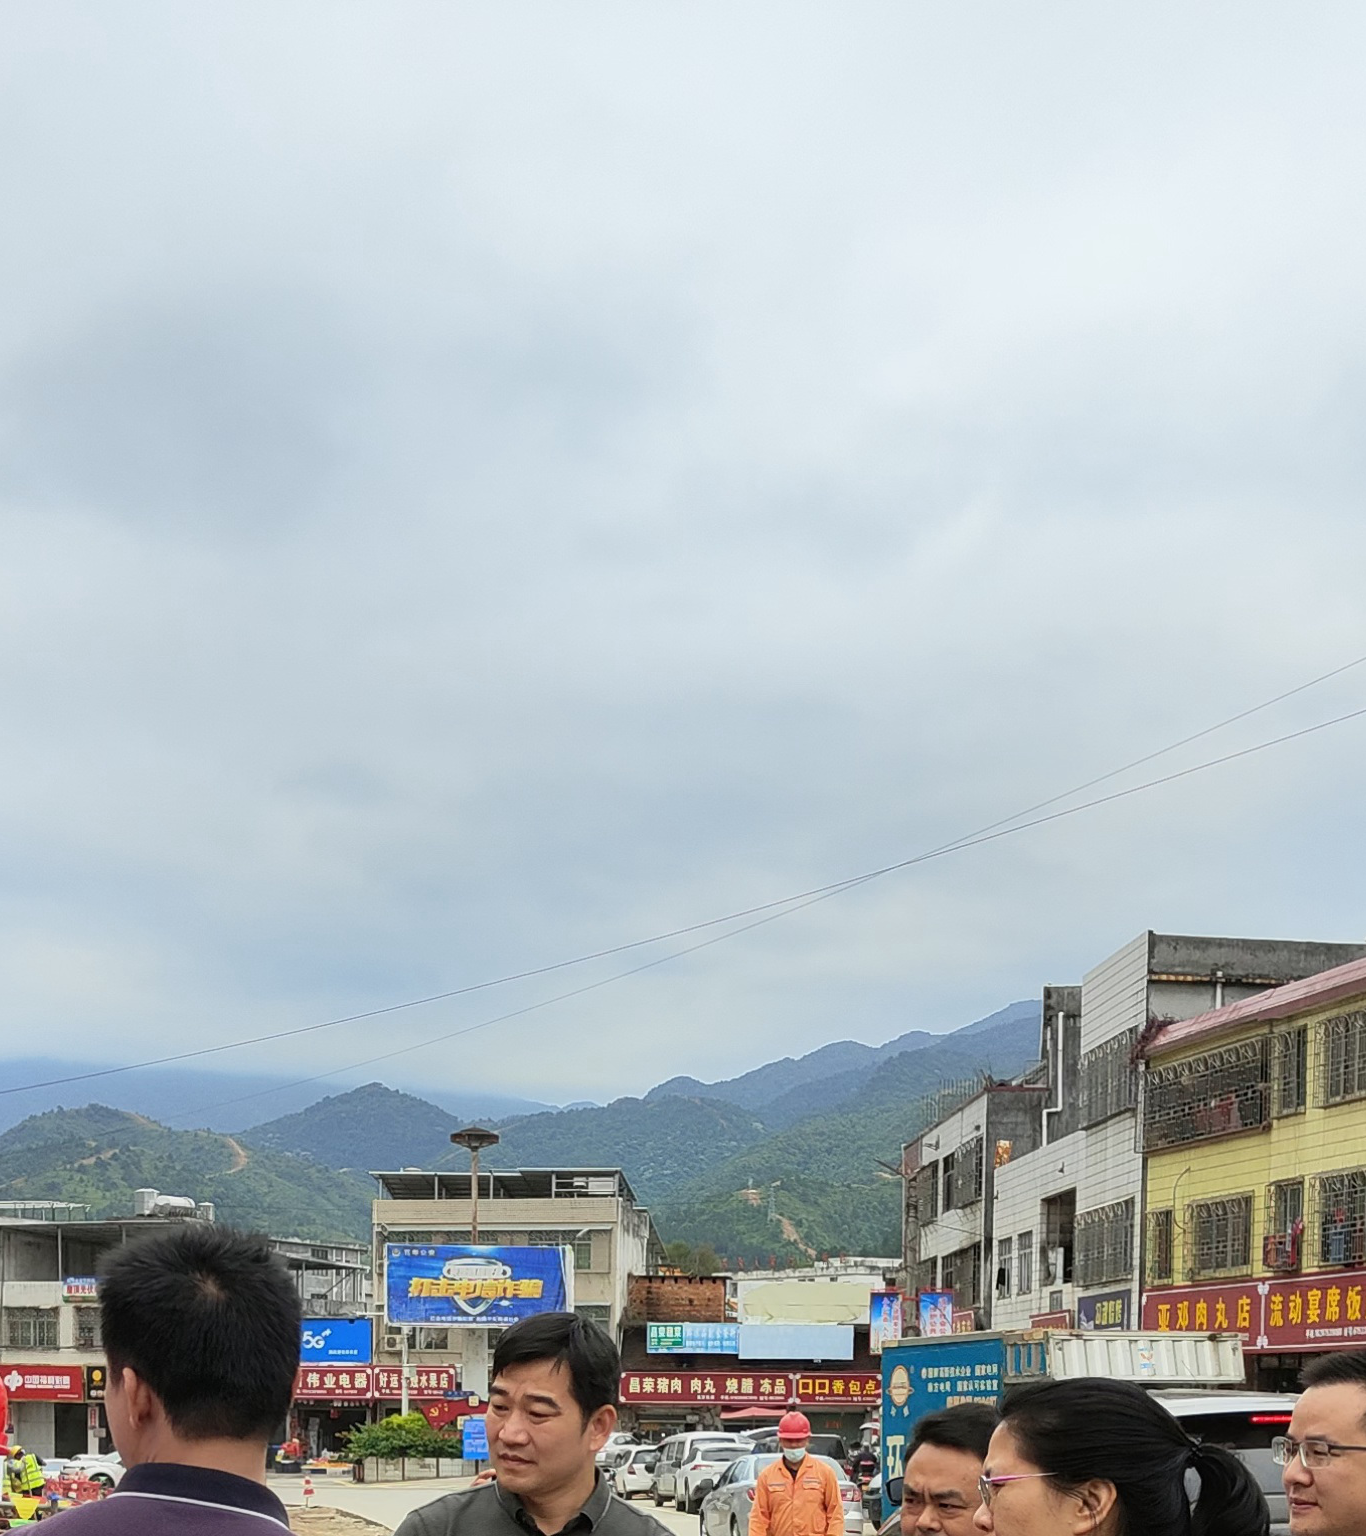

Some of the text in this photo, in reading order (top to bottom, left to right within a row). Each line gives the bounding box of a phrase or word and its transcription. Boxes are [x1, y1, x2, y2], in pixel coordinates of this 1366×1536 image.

[1157, 1295, 1252, 1332] 亚邓肉丸店
[302, 1330, 325, 1349] 5G
[299, 1372, 368, 1389] 伟业电器
[628, 1377, 683, 1394] 昌荣猪肉
[690, 1377, 717, 1394] 肉丸
[759, 1378, 787, 1395] 冻品
[798, 1378, 878, 1395] 口口香包点
